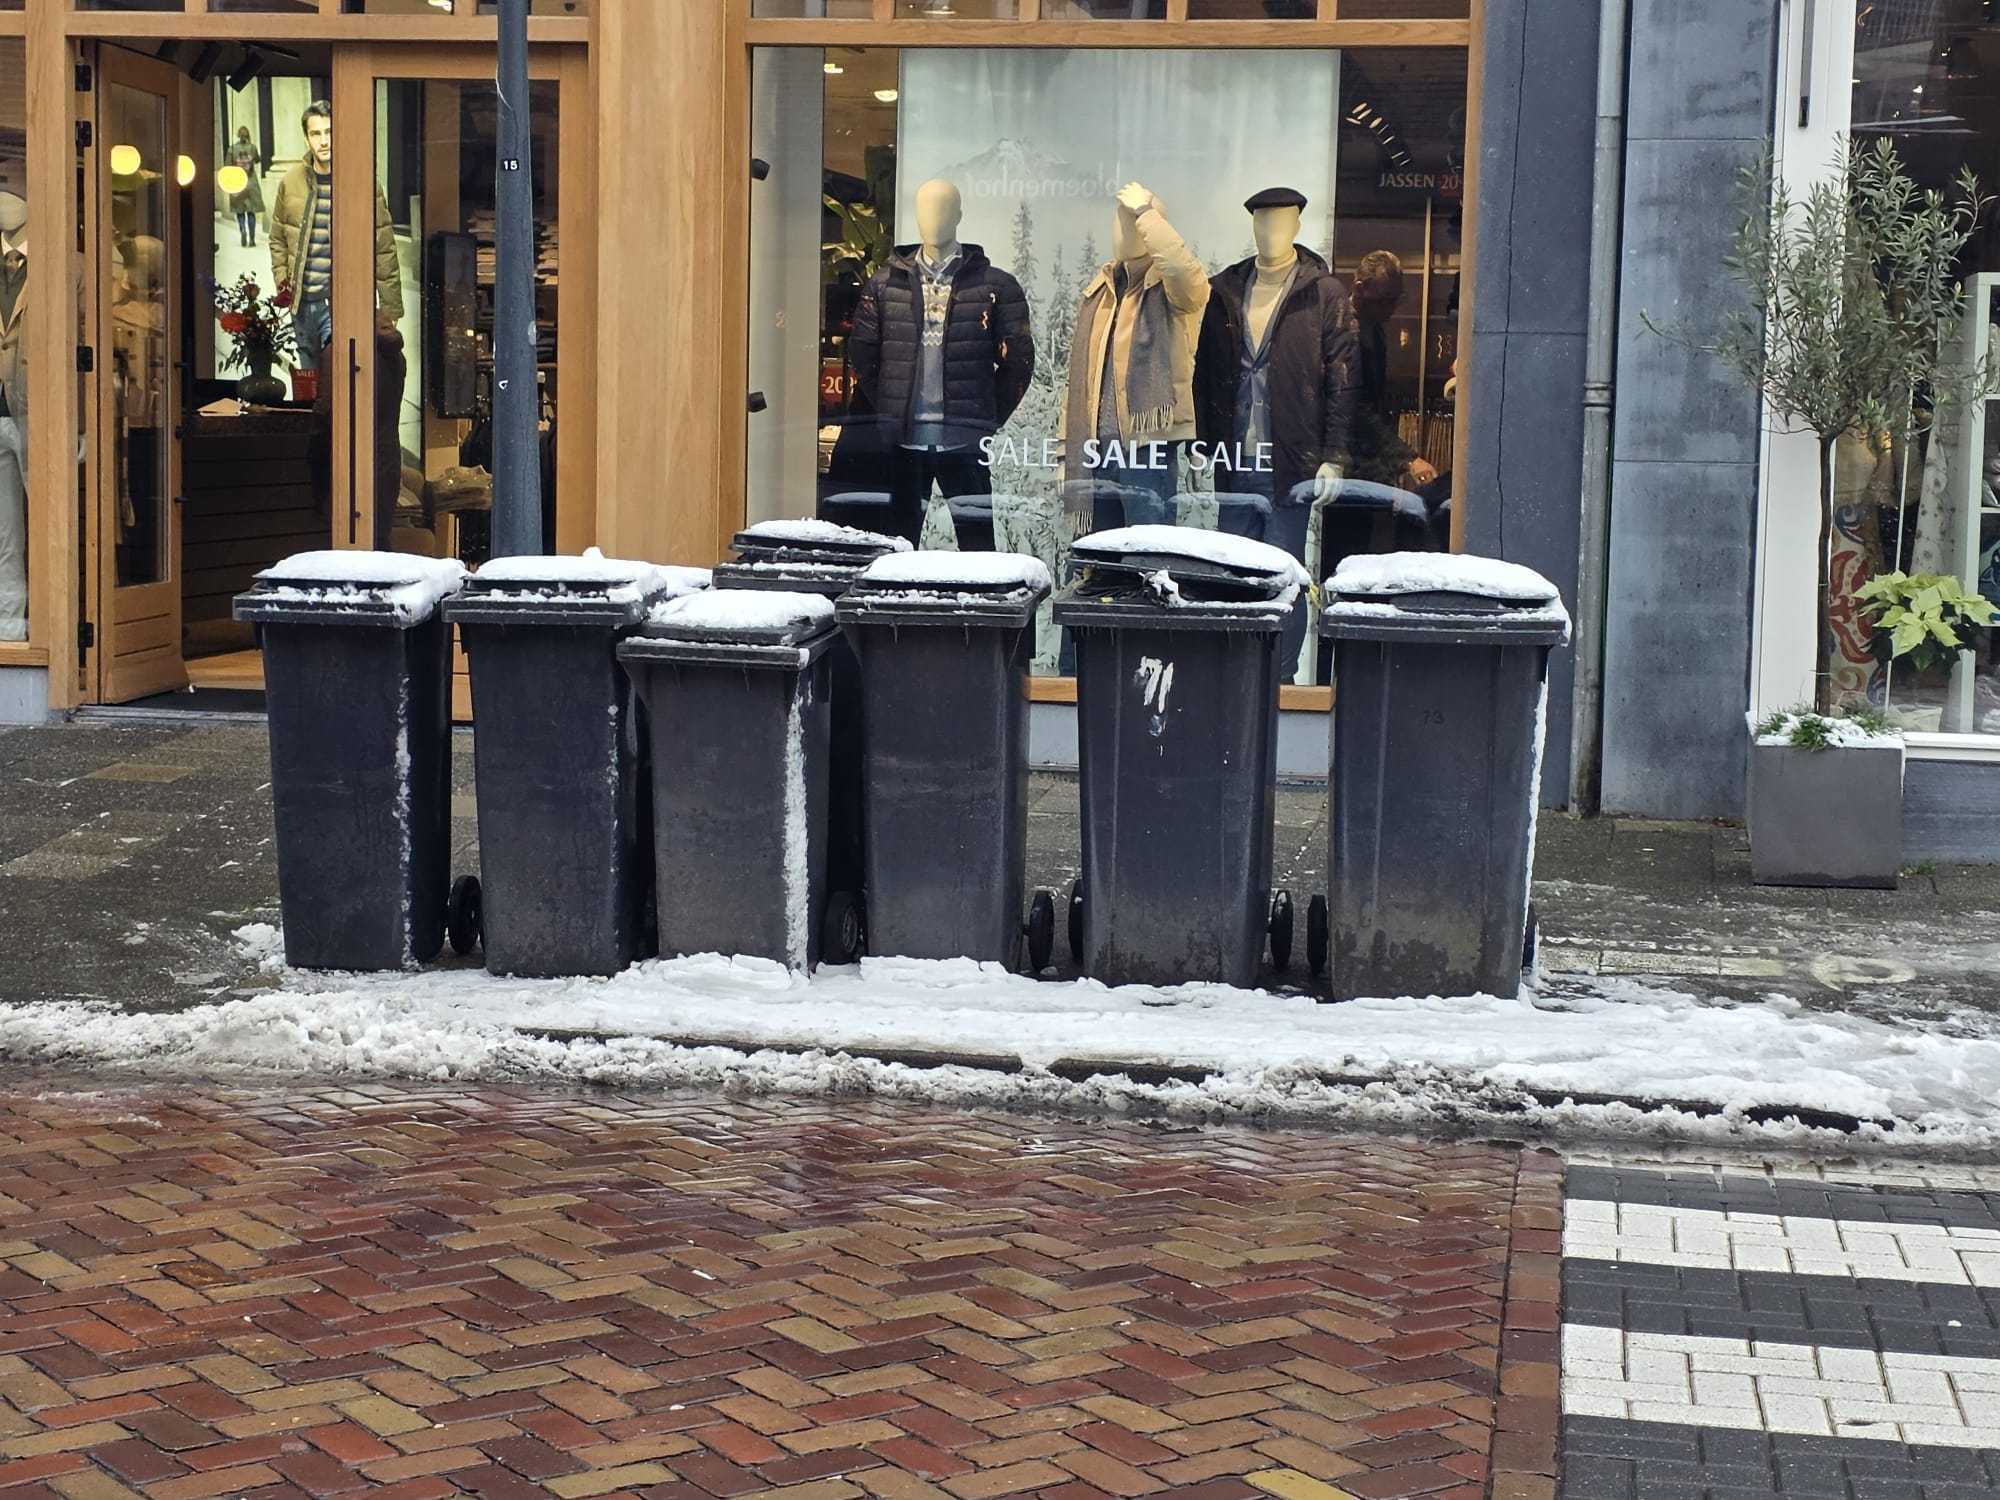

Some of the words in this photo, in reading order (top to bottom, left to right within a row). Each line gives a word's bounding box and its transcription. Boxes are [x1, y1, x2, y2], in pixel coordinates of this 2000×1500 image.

[503, 160, 518, 170] 15
[1378, 173, 1435, 188] JASSEN
[977, 435, 1059, 468] SALE
[1082, 438, 1168, 470] SALE
[1188, 440, 1274, 473] SALE
